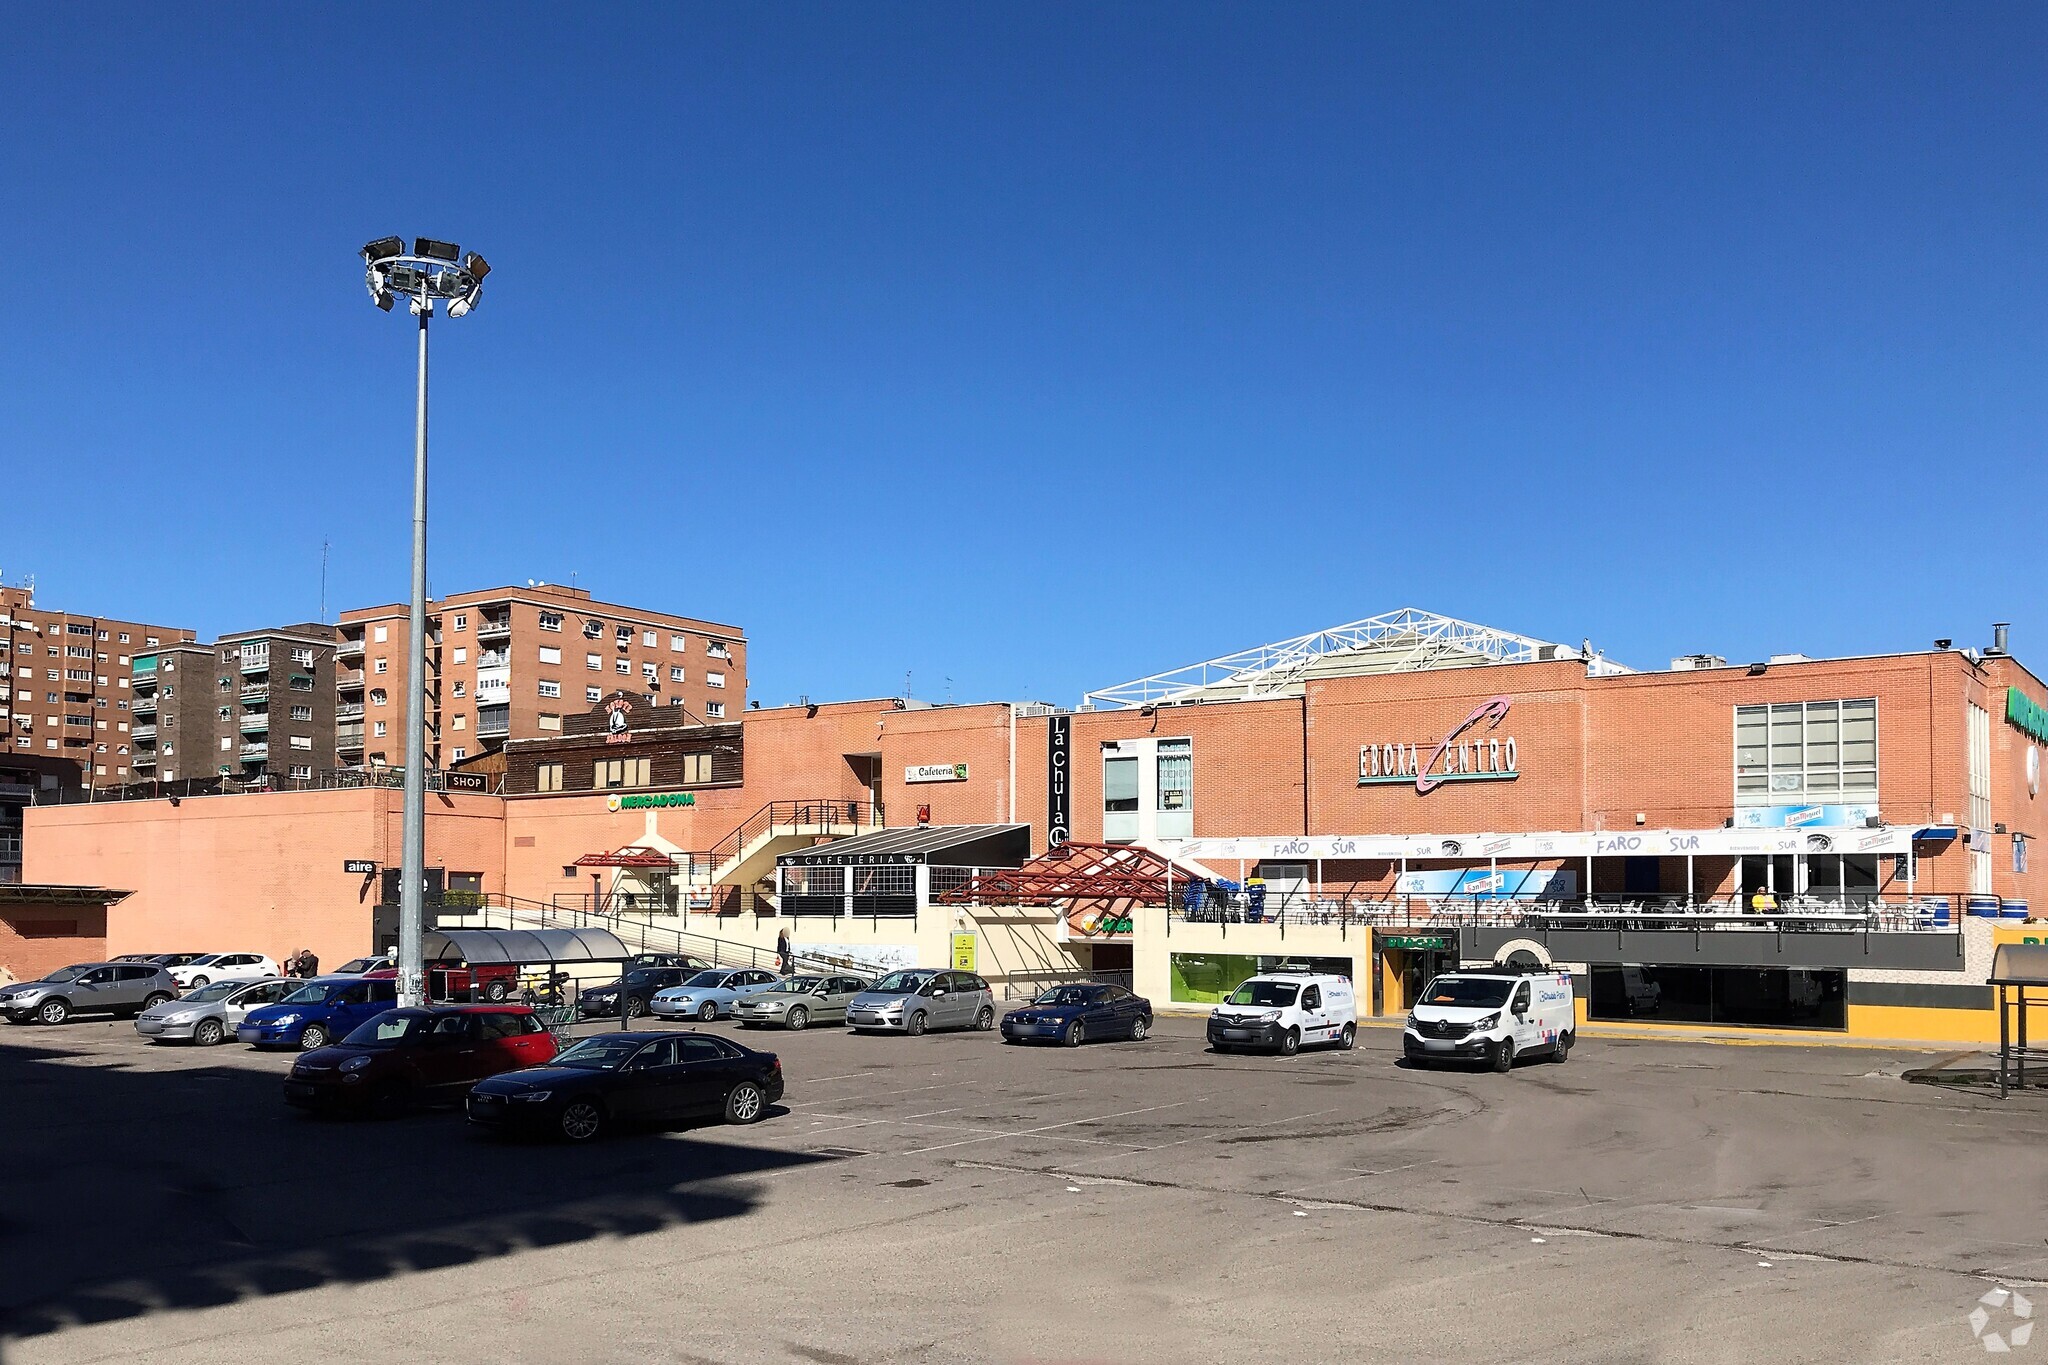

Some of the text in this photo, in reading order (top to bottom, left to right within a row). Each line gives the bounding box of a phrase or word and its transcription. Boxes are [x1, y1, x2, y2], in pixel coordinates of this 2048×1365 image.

[1359, 742, 1418, 776] EBORA
[918, 766, 953, 776] Cafeteria
[453, 776, 481, 787] SHOP
[621, 793, 695, 809] MERCADONA
[1274, 842, 1309, 856] FARO
[1332, 841, 1356, 855] SUR
[1597, 836, 1642, 853] FARO
[1670, 835, 1700, 852] SUR
[1778, 840, 1797, 850] SUR
[1416, 846, 1431, 856] SUR
[805, 855, 895, 865] CAFETERIA
[348, 862, 373, 872] aire
[1387, 937, 1444, 949] BURGER
